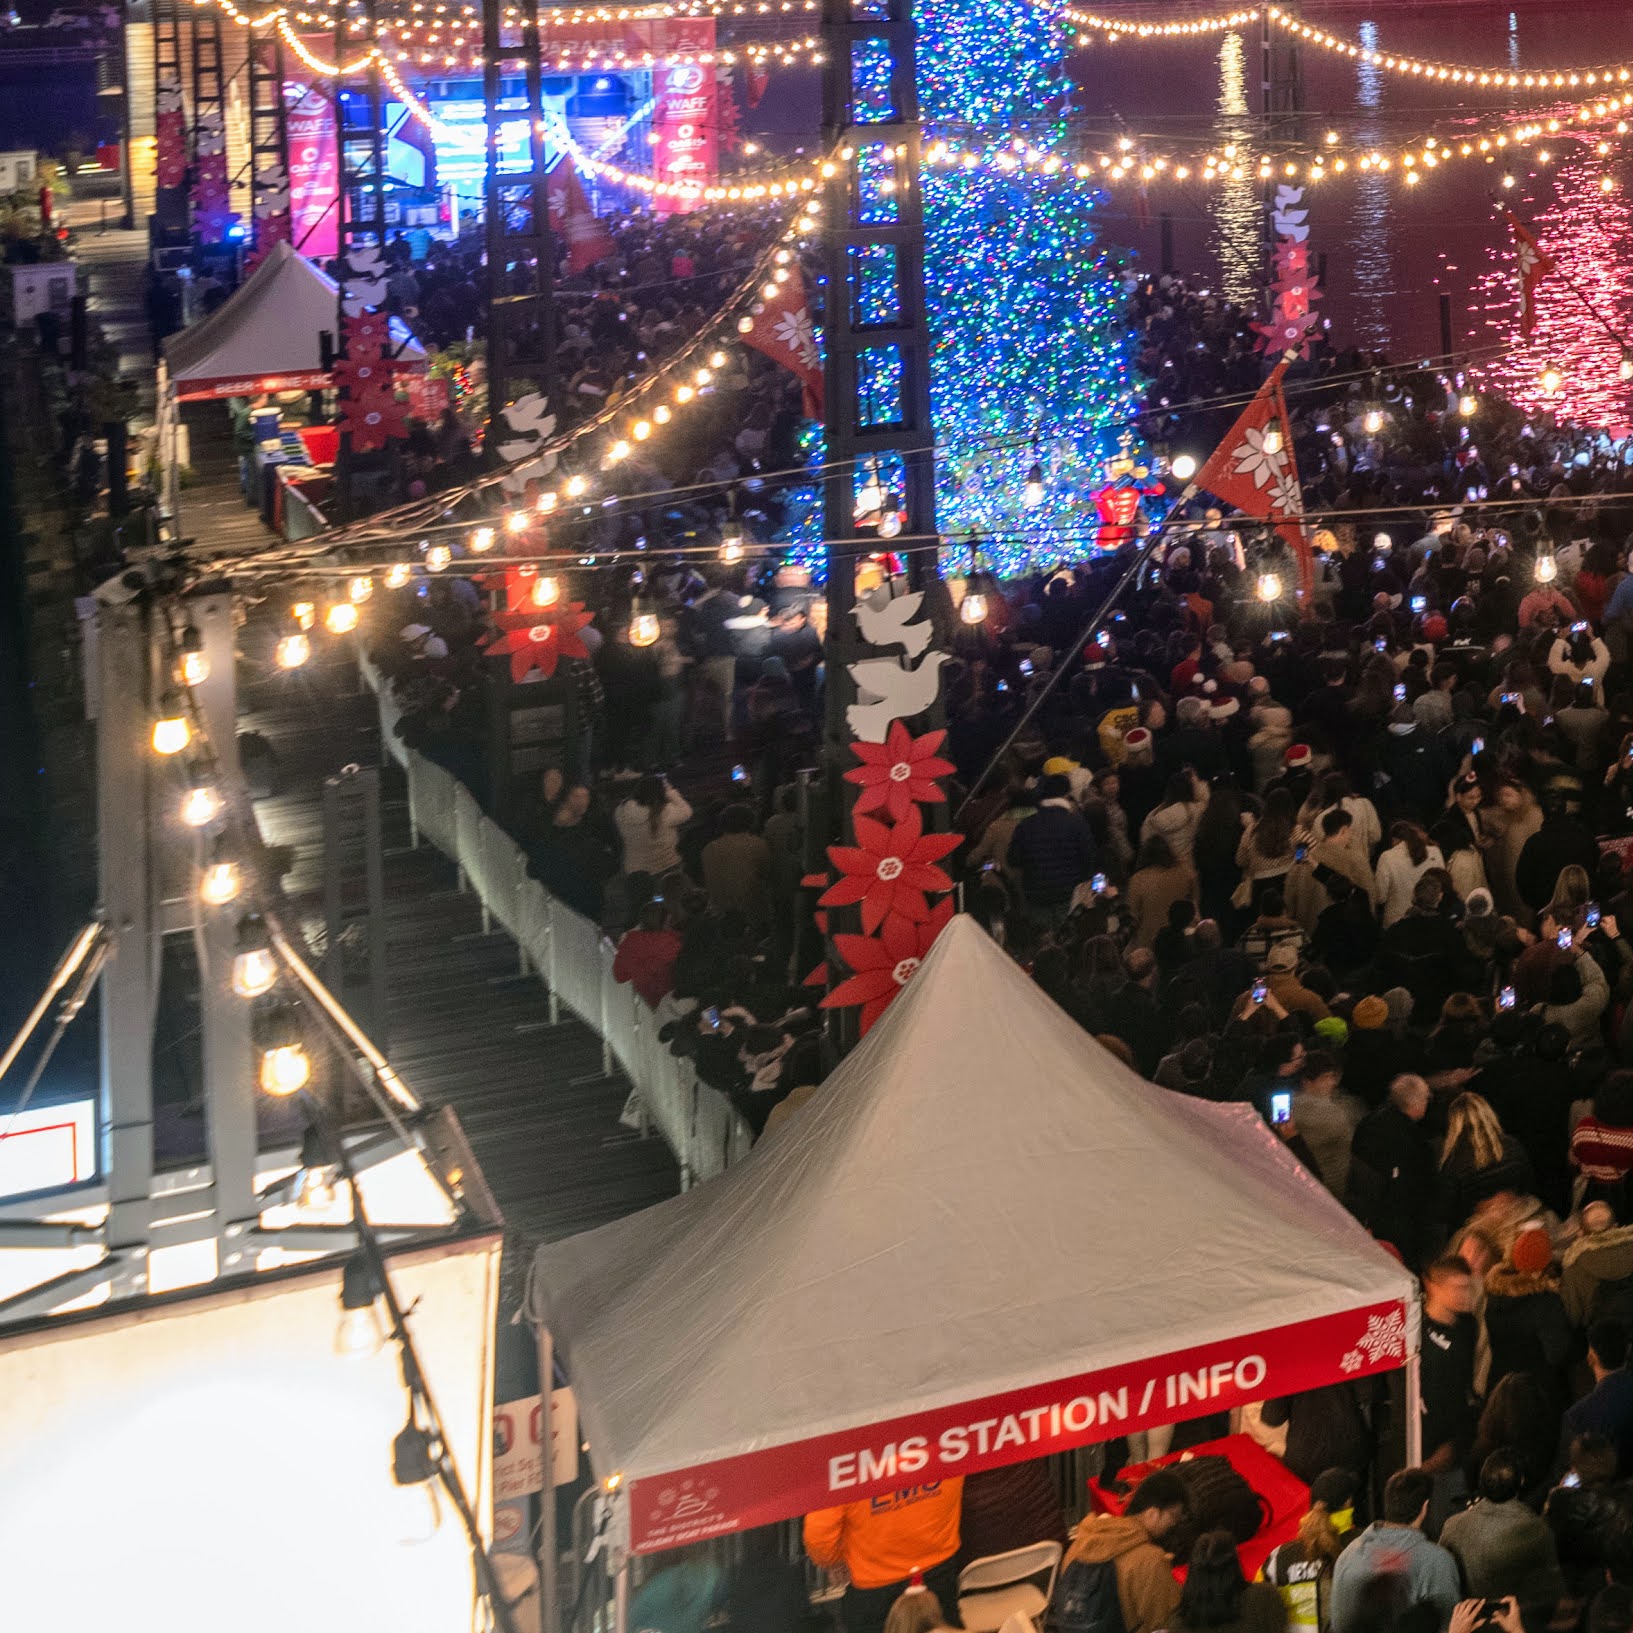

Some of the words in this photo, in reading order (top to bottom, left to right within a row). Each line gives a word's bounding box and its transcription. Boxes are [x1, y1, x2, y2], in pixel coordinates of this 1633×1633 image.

[666, 97, 707, 110] WAFF
[287, 119, 334, 132] WAFF
[215, 380, 254, 394] BEER
[828, 1435, 929, 1492] EMS
[938, 1385, 1129, 1464] STATION
[1137, 1378, 1157, 1416] /
[1166, 1354, 1268, 1408] INFO
[636, 1534, 675, 1550] HOLIDAY
[675, 1528, 701, 1542] BOAT
[701, 1518, 739, 1536] PARADE
